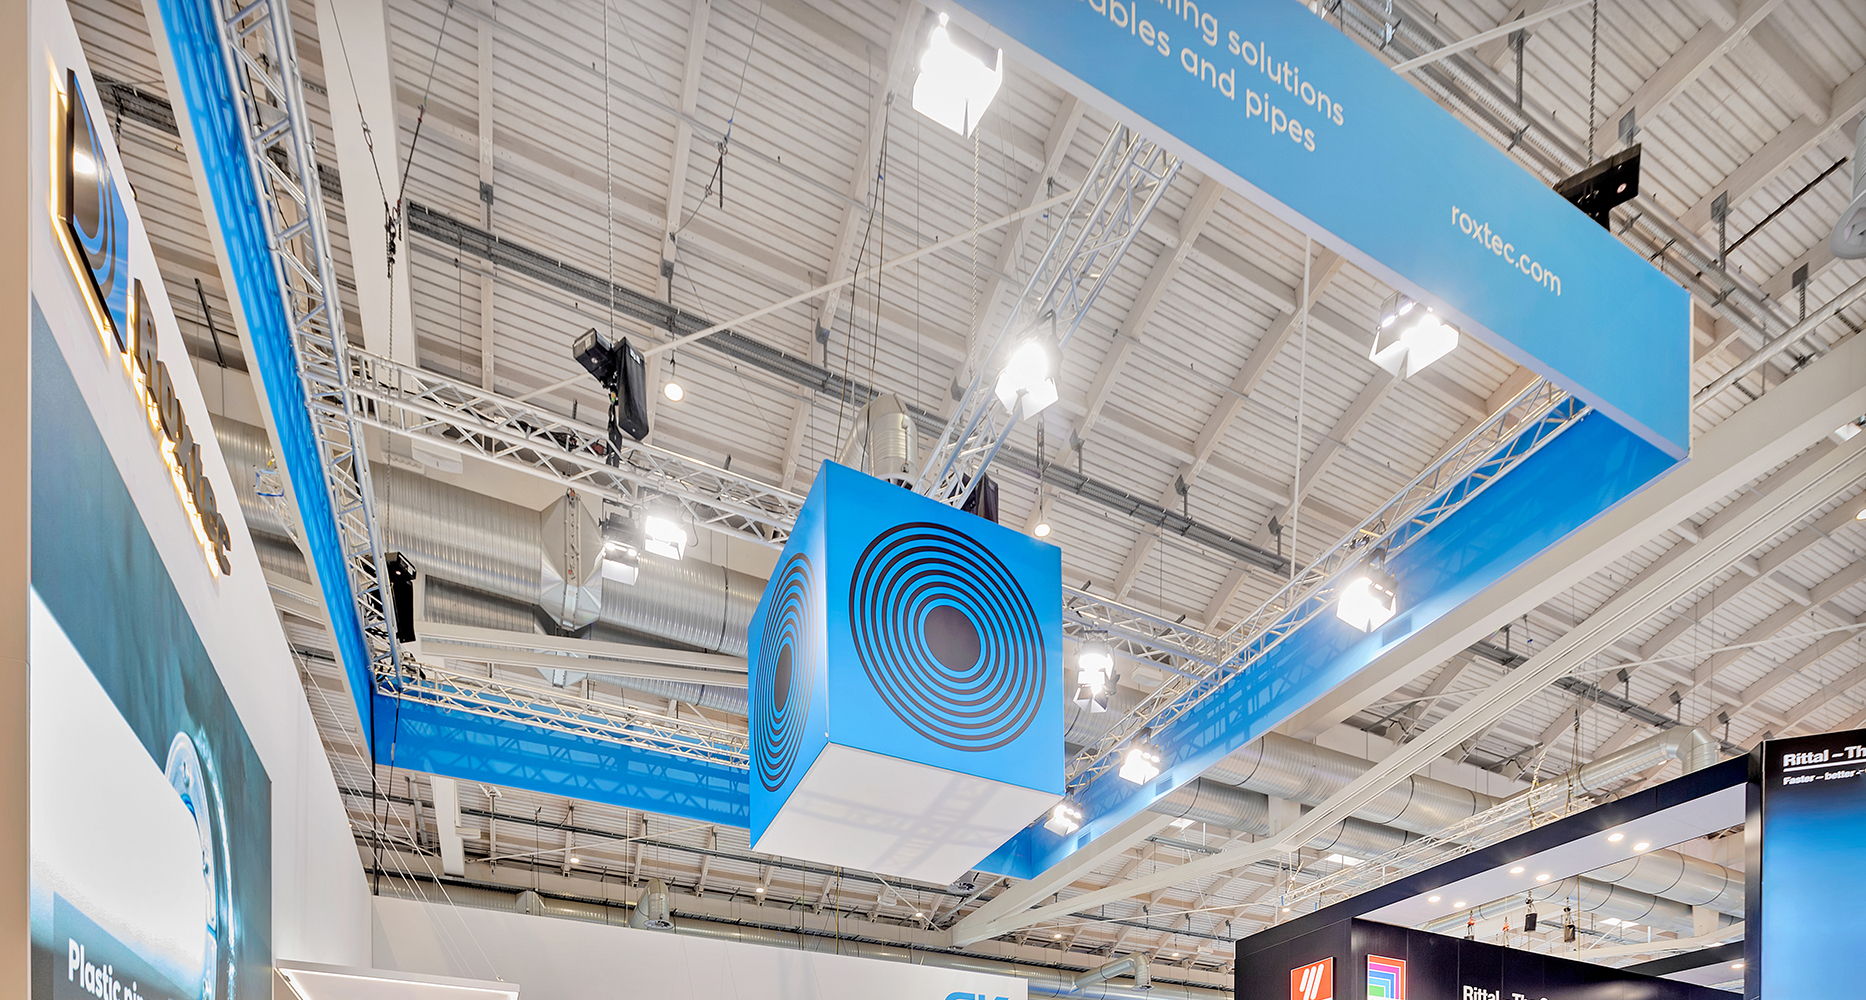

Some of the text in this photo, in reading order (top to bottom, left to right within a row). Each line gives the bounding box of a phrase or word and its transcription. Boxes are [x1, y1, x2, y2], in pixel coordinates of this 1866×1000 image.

[1181, 47, 1236, 101] and
[1246, 88, 1316, 152] pipes
[1228, 30, 1344, 126] solutions
[1451, 205, 1562, 297] roxtec.com
[1783, 749, 1829, 767] Rittal
[1783, 775, 1816, 786] Faster
[1824, 770, 1856, 780] better
